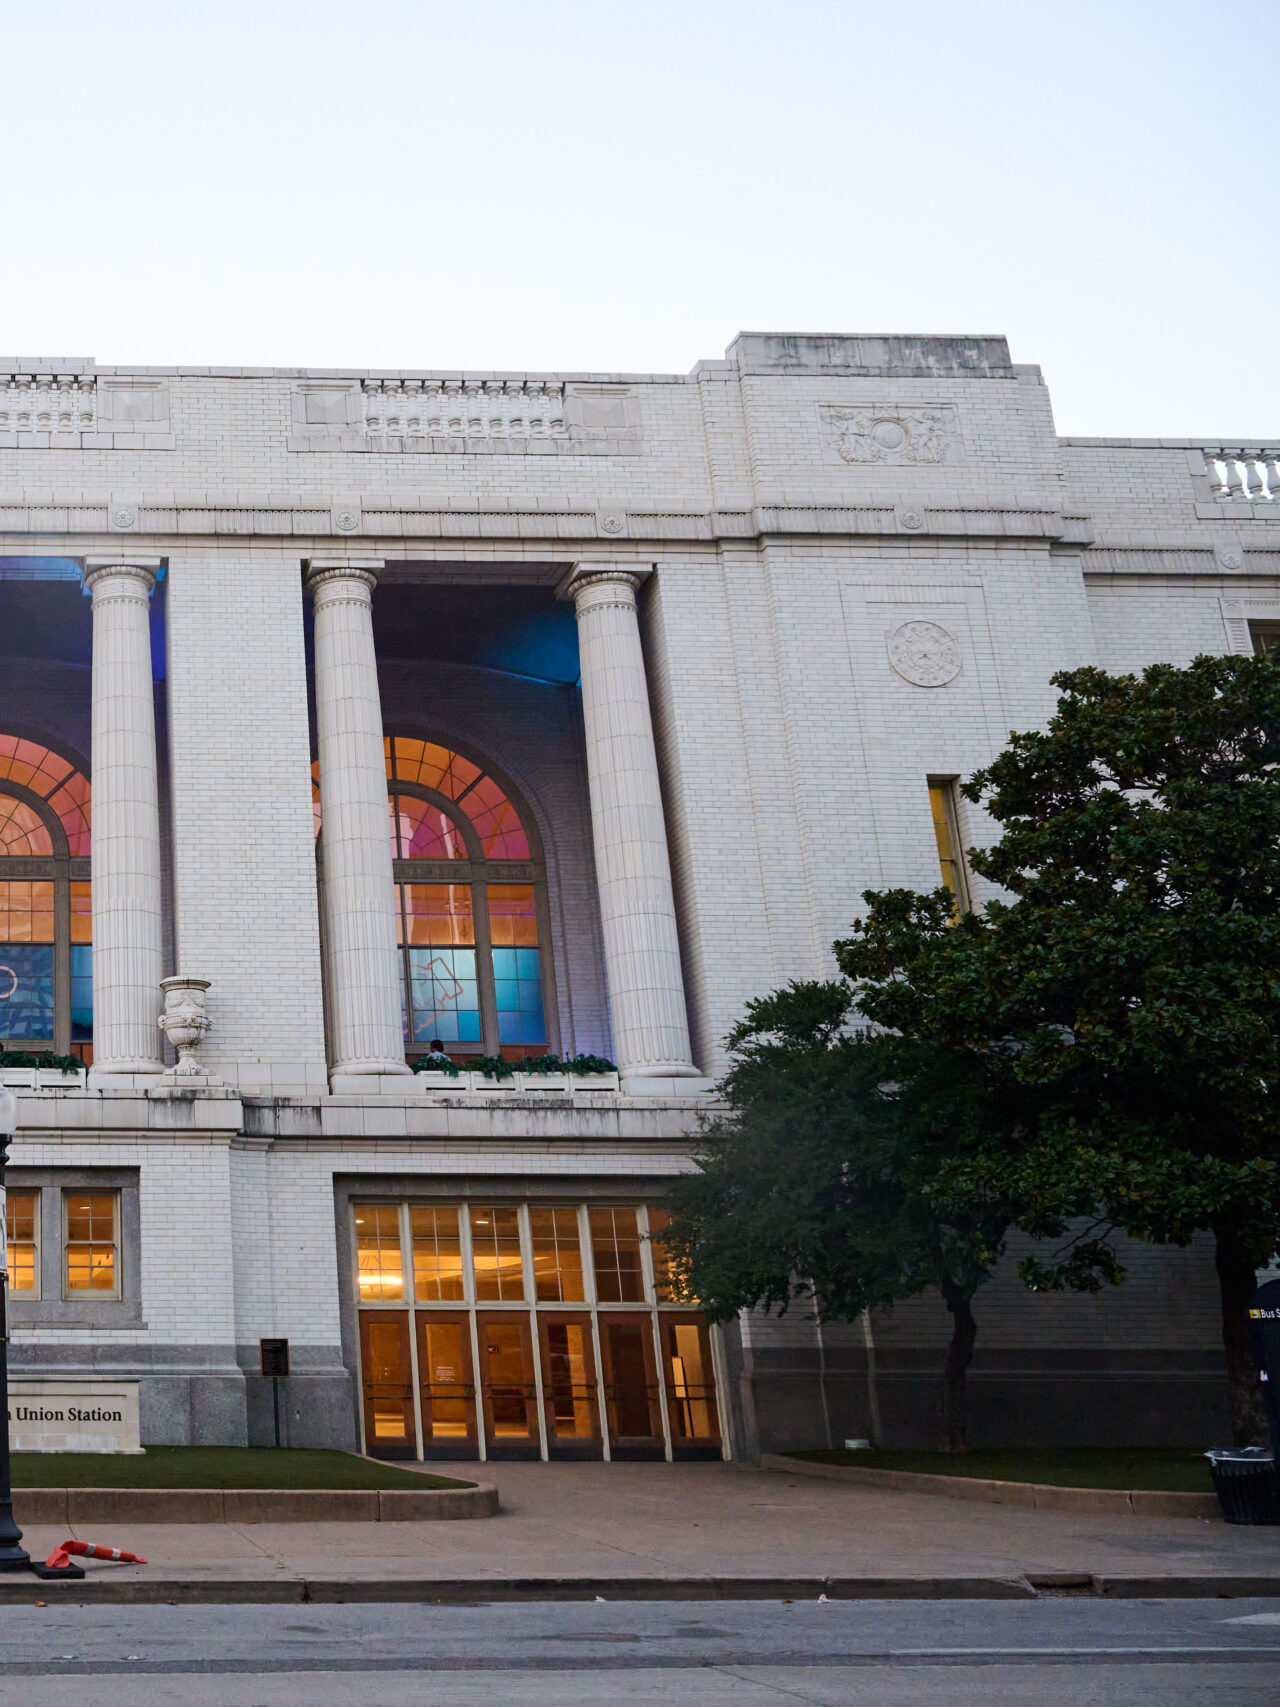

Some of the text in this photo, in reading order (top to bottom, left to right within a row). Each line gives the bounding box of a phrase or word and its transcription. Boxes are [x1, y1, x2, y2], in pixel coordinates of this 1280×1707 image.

[1261, 1309, 1275, 1319] Bus
[15, 1406, 65, 1421] Union
[67, 1407, 122, 1422] Station
